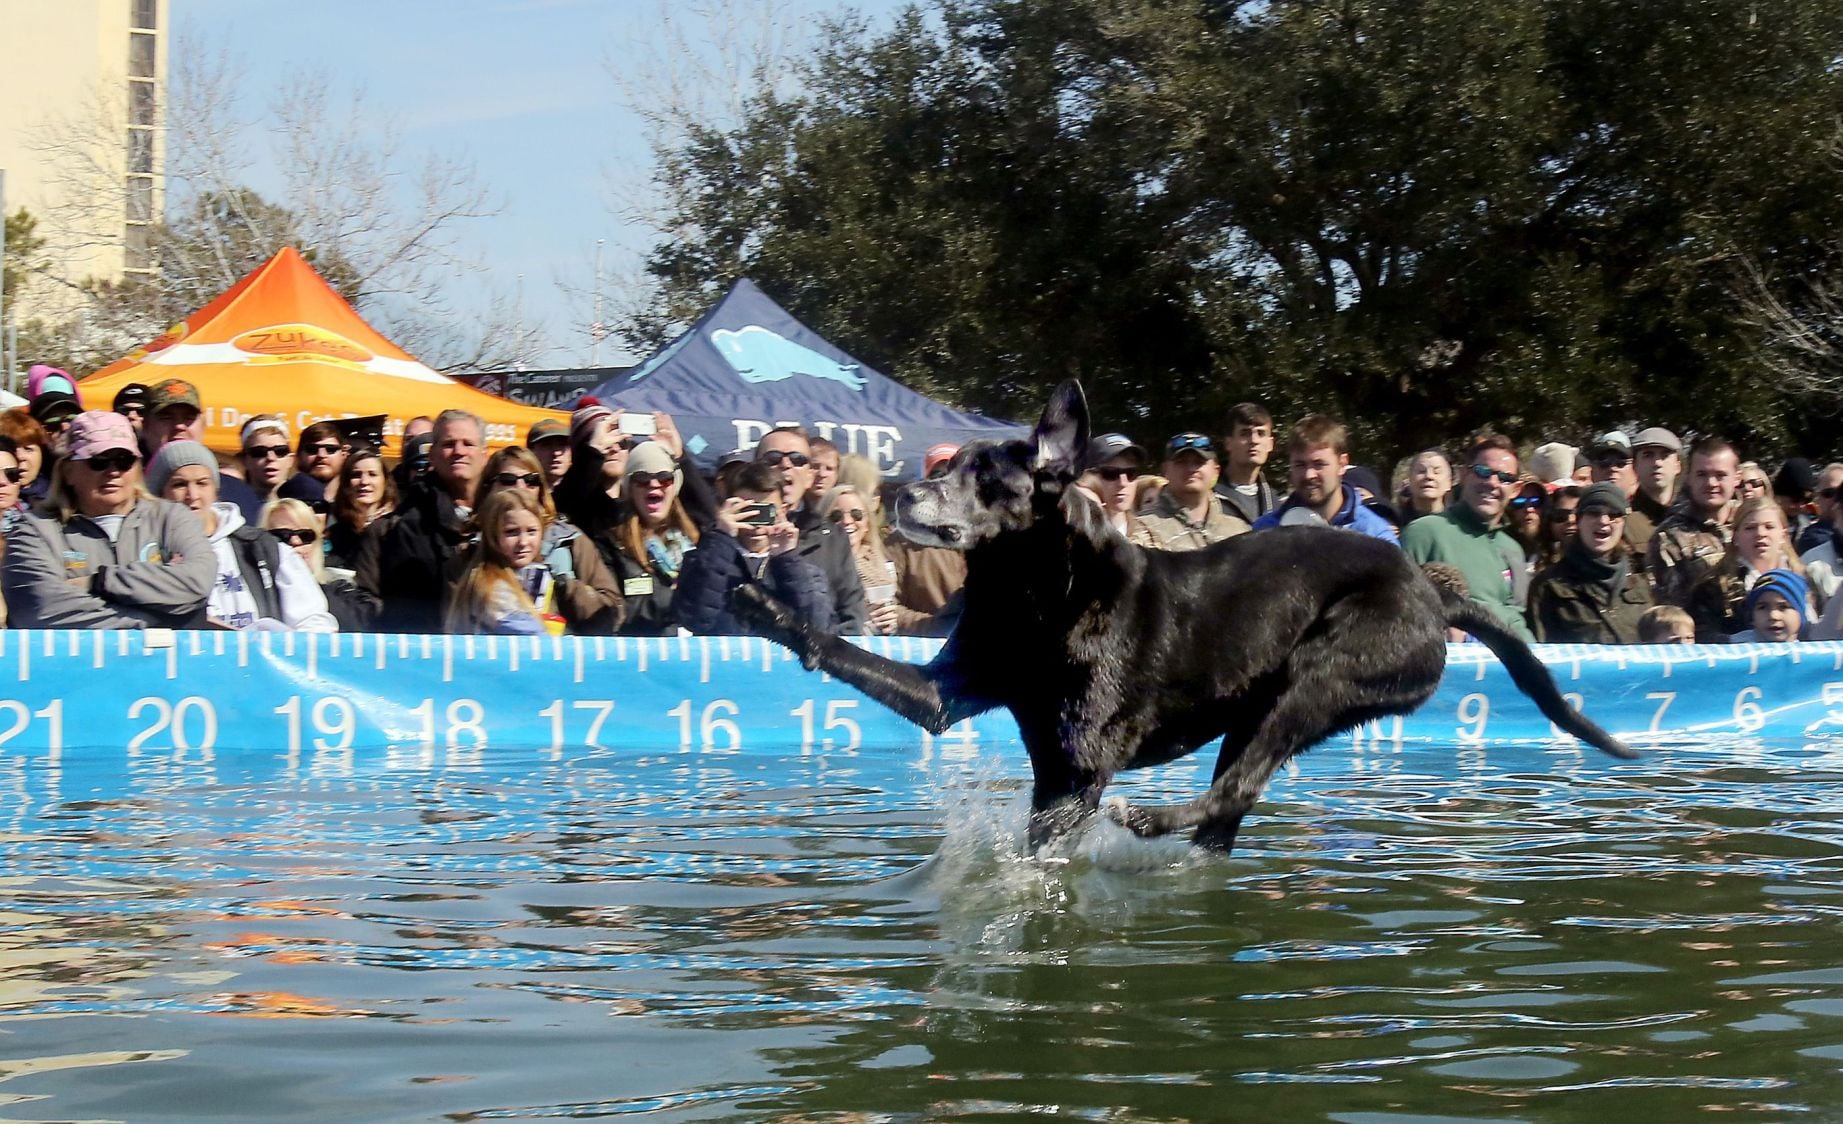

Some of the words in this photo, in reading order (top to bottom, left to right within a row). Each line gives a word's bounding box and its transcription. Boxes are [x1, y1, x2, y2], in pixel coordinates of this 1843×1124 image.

[730, 419, 904, 477] BUE
[0, 698, 63, 752] 21
[127, 696, 218, 752] 20
[273, 695, 356, 751] 19
[407, 698, 488, 750] 18
[538, 699, 615, 748] 17
[667, 699, 742, 753] 16
[791, 698, 863, 752] 15
[1455, 692, 1489, 742] 9
[1646, 691, 1677, 733] 7
[1733, 686, 1767, 734] 6
